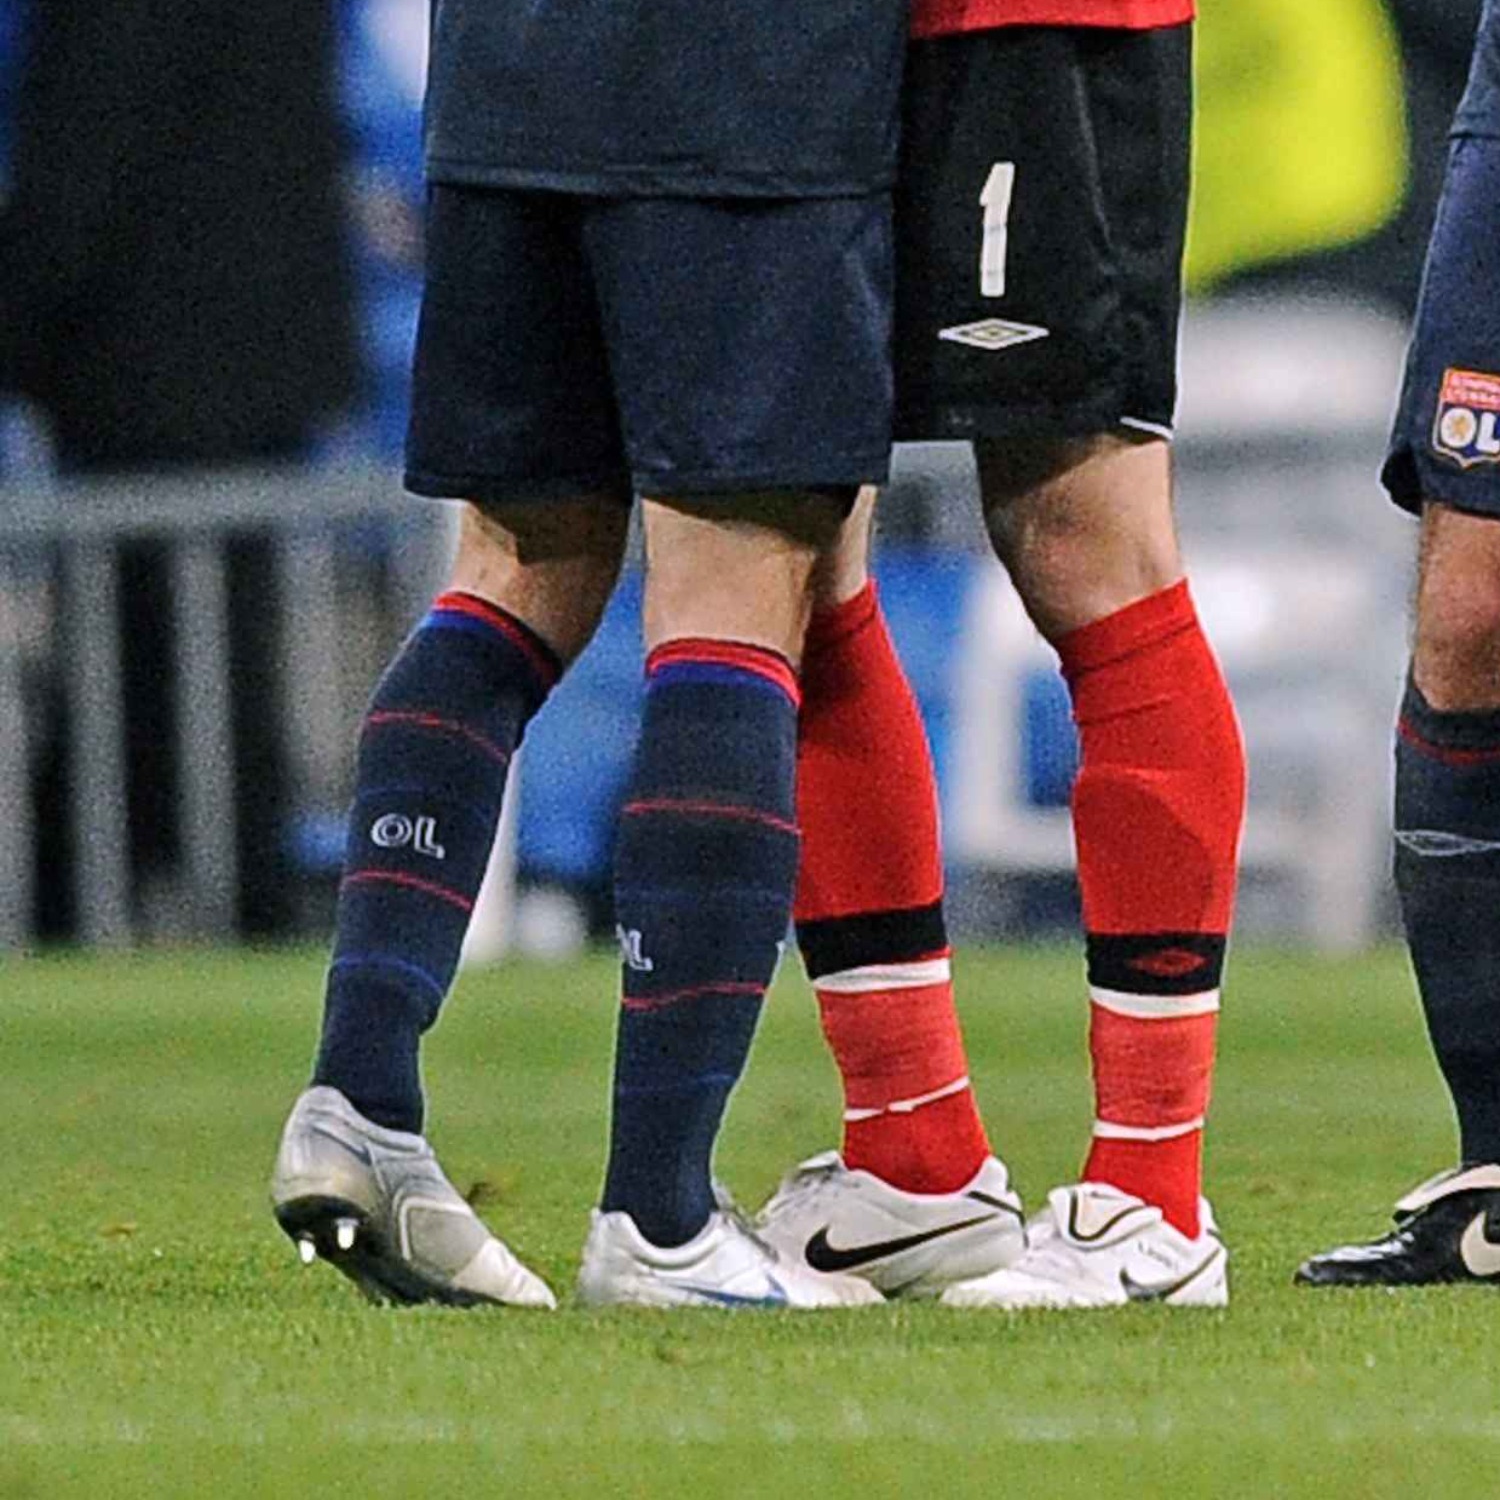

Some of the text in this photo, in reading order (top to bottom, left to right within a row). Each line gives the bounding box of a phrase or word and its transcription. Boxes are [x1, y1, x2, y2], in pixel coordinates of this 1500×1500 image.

[979, 162, 1016, 297] 1
[1441, 408, 1500, 453] OL
[371, 813, 445, 859] OL
